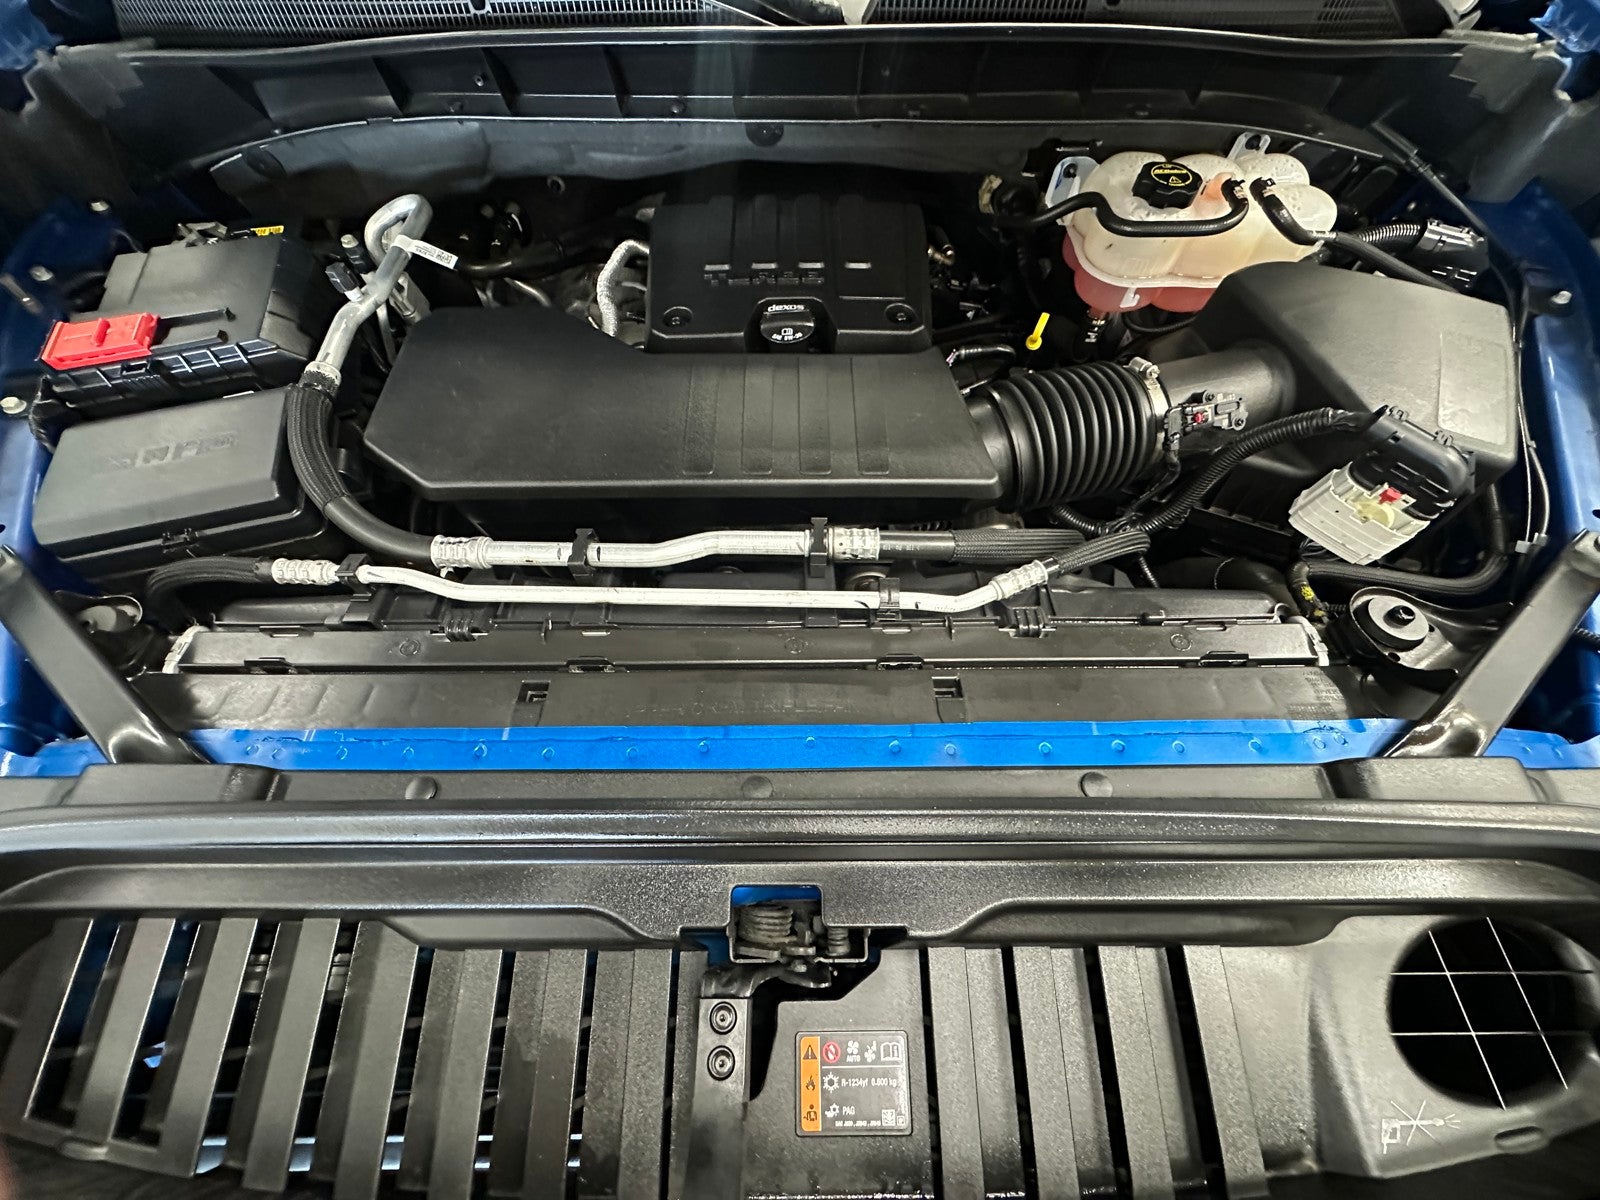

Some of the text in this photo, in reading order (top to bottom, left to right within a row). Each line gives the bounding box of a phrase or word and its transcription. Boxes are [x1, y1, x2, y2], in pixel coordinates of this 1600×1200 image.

[768, 304, 805, 312] dexos
[846, 1054, 861, 1063] AUTO
[842, 1105, 856, 1115] PAG
